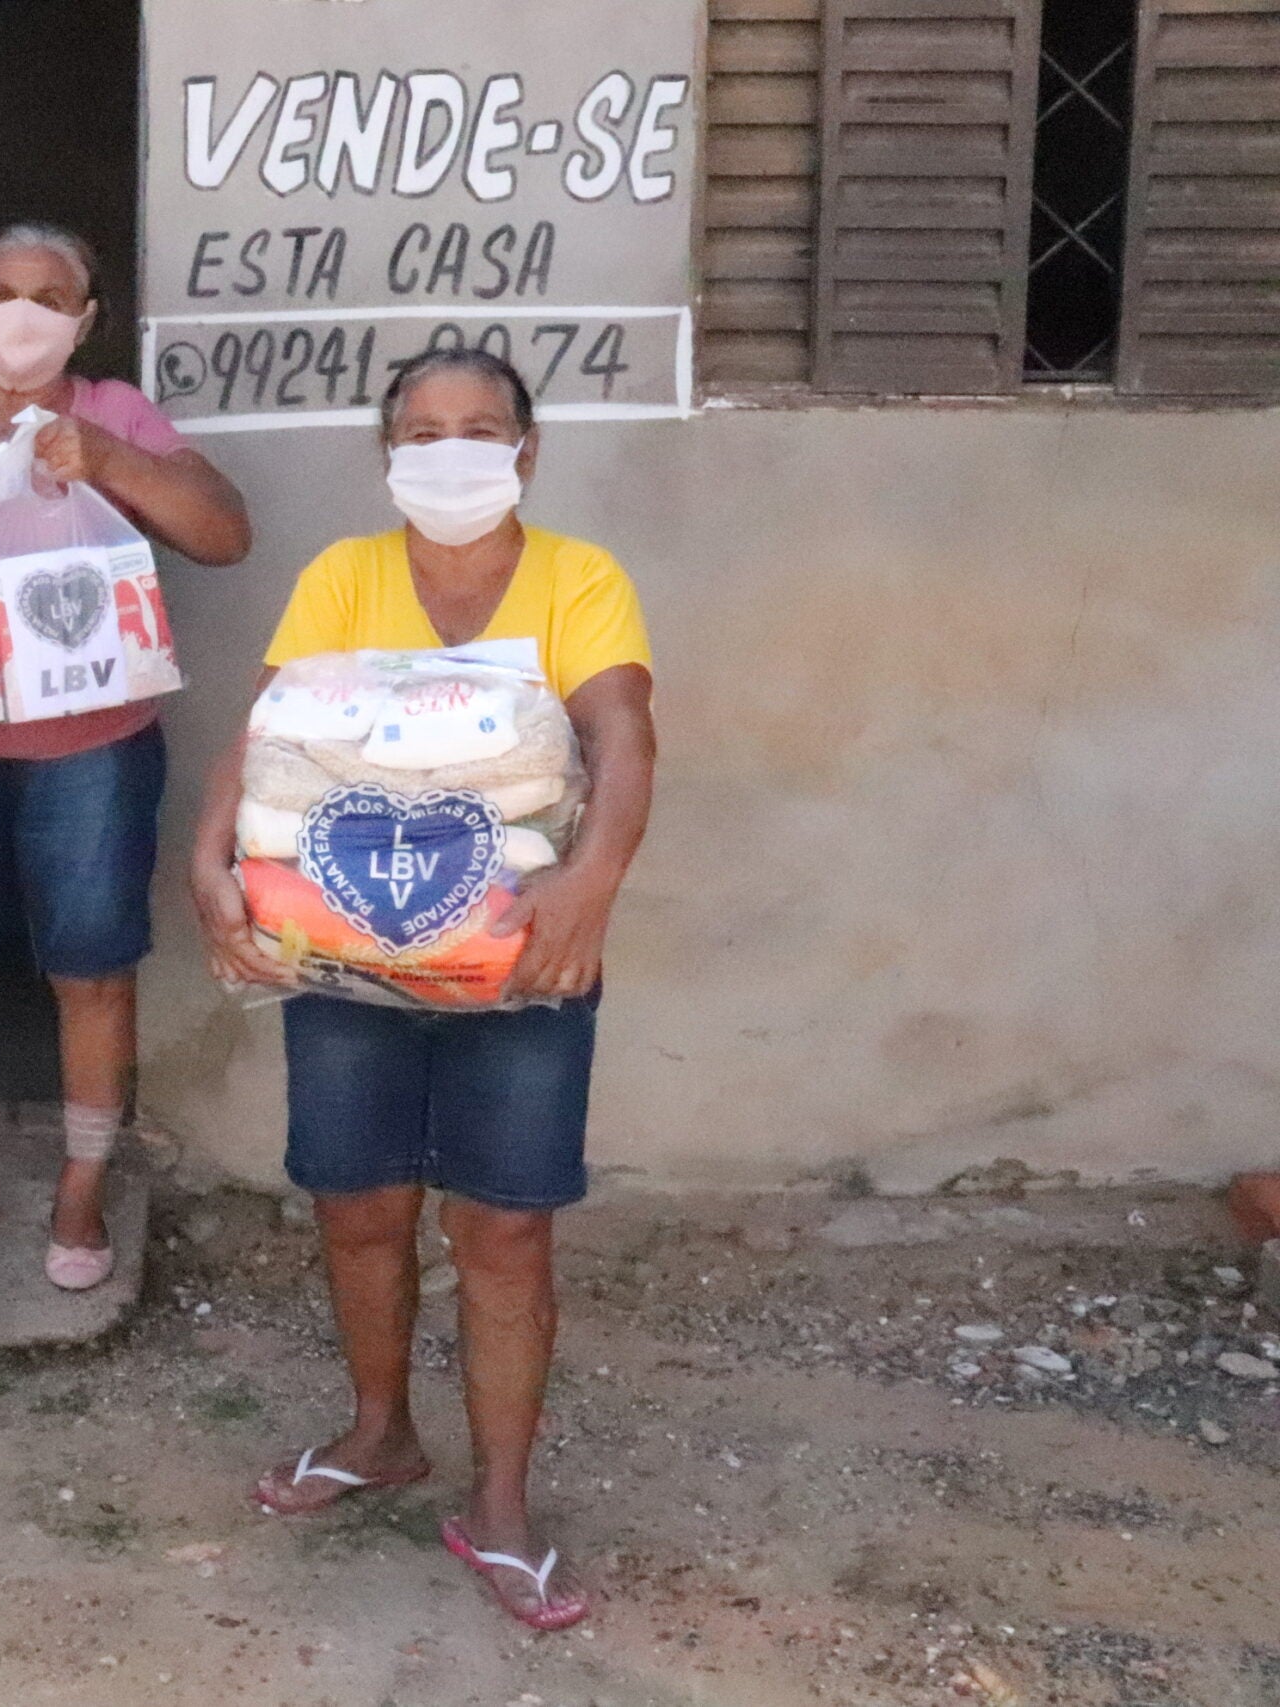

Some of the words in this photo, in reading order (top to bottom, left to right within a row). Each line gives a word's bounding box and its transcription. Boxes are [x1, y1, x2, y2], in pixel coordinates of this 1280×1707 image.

[183, 68, 690, 203] VENDE-SE
[186, 226, 348, 298] ESTA
[386, 220, 556, 300] CASA
[40, 657, 117, 699] LBV
[343, 799, 386, 815] AOS
[314, 808, 343, 867] TERRA
[394, 824, 414, 850] L
[467, 832, 490, 873] BOA
[326, 863, 350, 890] NA
[369, 851, 441, 881] LBV
[341, 884, 375, 918] PAZ
[388, 881, 414, 911] V
[400, 874, 475, 937] VONTADE
